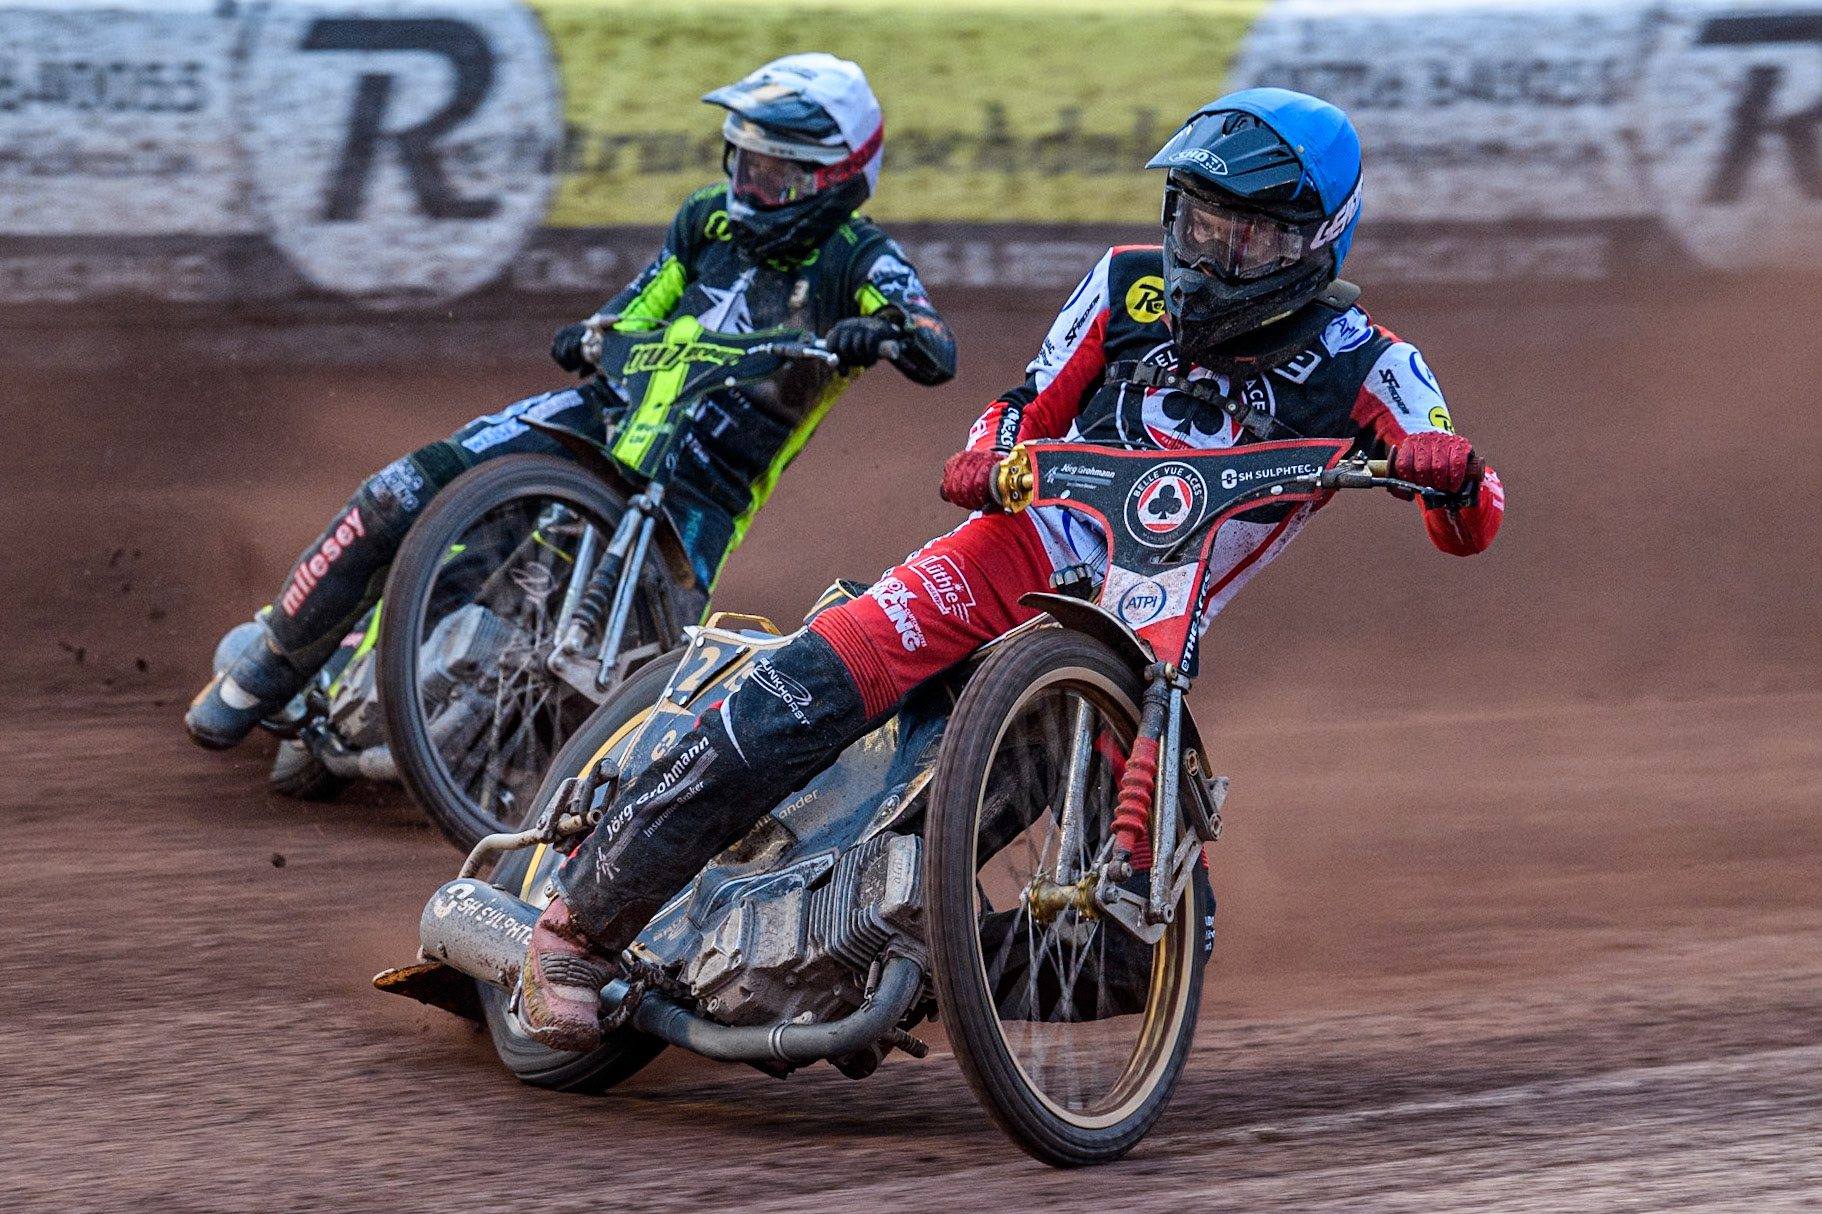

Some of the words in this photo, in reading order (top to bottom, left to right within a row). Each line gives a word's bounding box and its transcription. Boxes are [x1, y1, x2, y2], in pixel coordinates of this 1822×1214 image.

[301, 18, 501, 221] R
[1133, 472, 1160, 498] BELLE
[1164, 466, 1185, 476] VUE
[1184, 473, 1202, 496] ACES
[1239, 471, 1253, 481] SH
[919, 559, 960, 604] Lüthje
[1125, 595, 1158, 609] ATPI
[606, 804, 634, 842] Jörg
[635, 736, 710, 805] Grohmann
